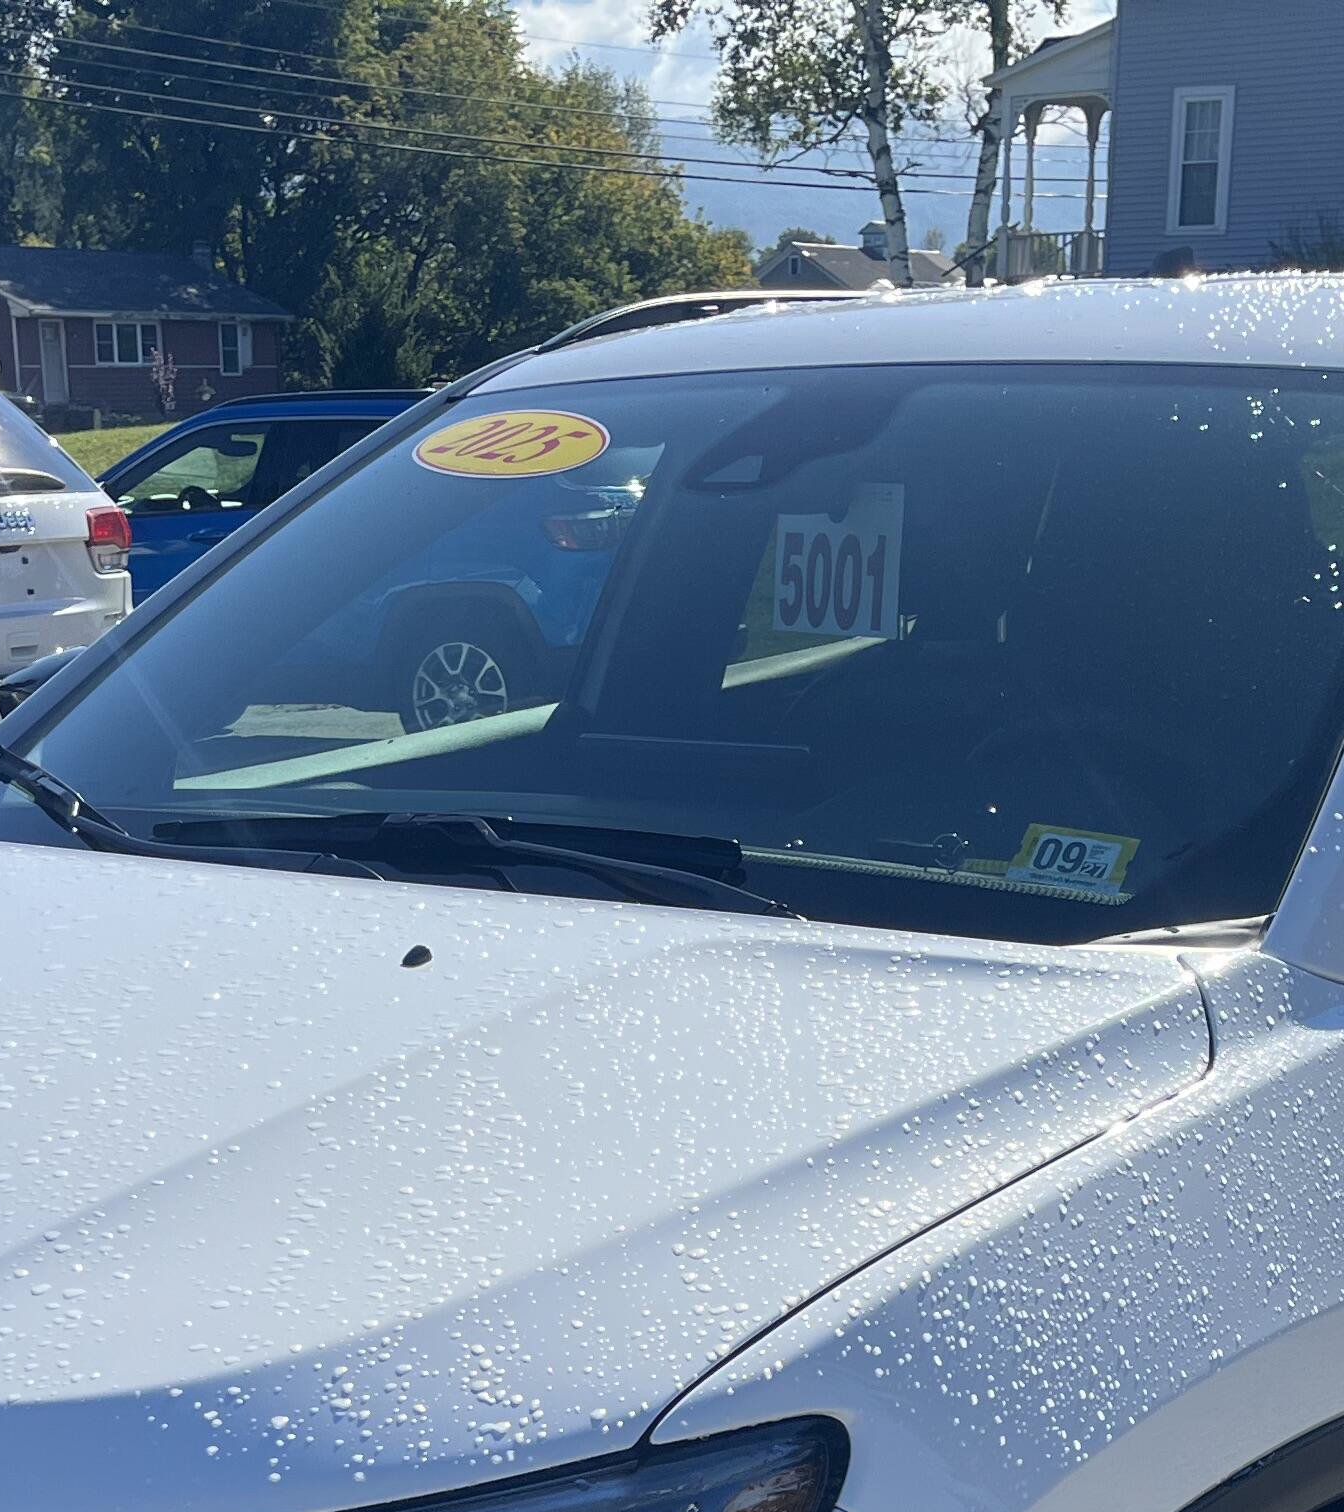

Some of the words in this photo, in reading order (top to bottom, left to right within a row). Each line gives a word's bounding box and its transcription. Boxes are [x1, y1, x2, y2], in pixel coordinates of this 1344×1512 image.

[428, 419, 592, 464] 2025
[779, 532, 887, 631] 5001
[1033, 838, 1088, 874] 09
[1081, 862, 1107, 879] 27
